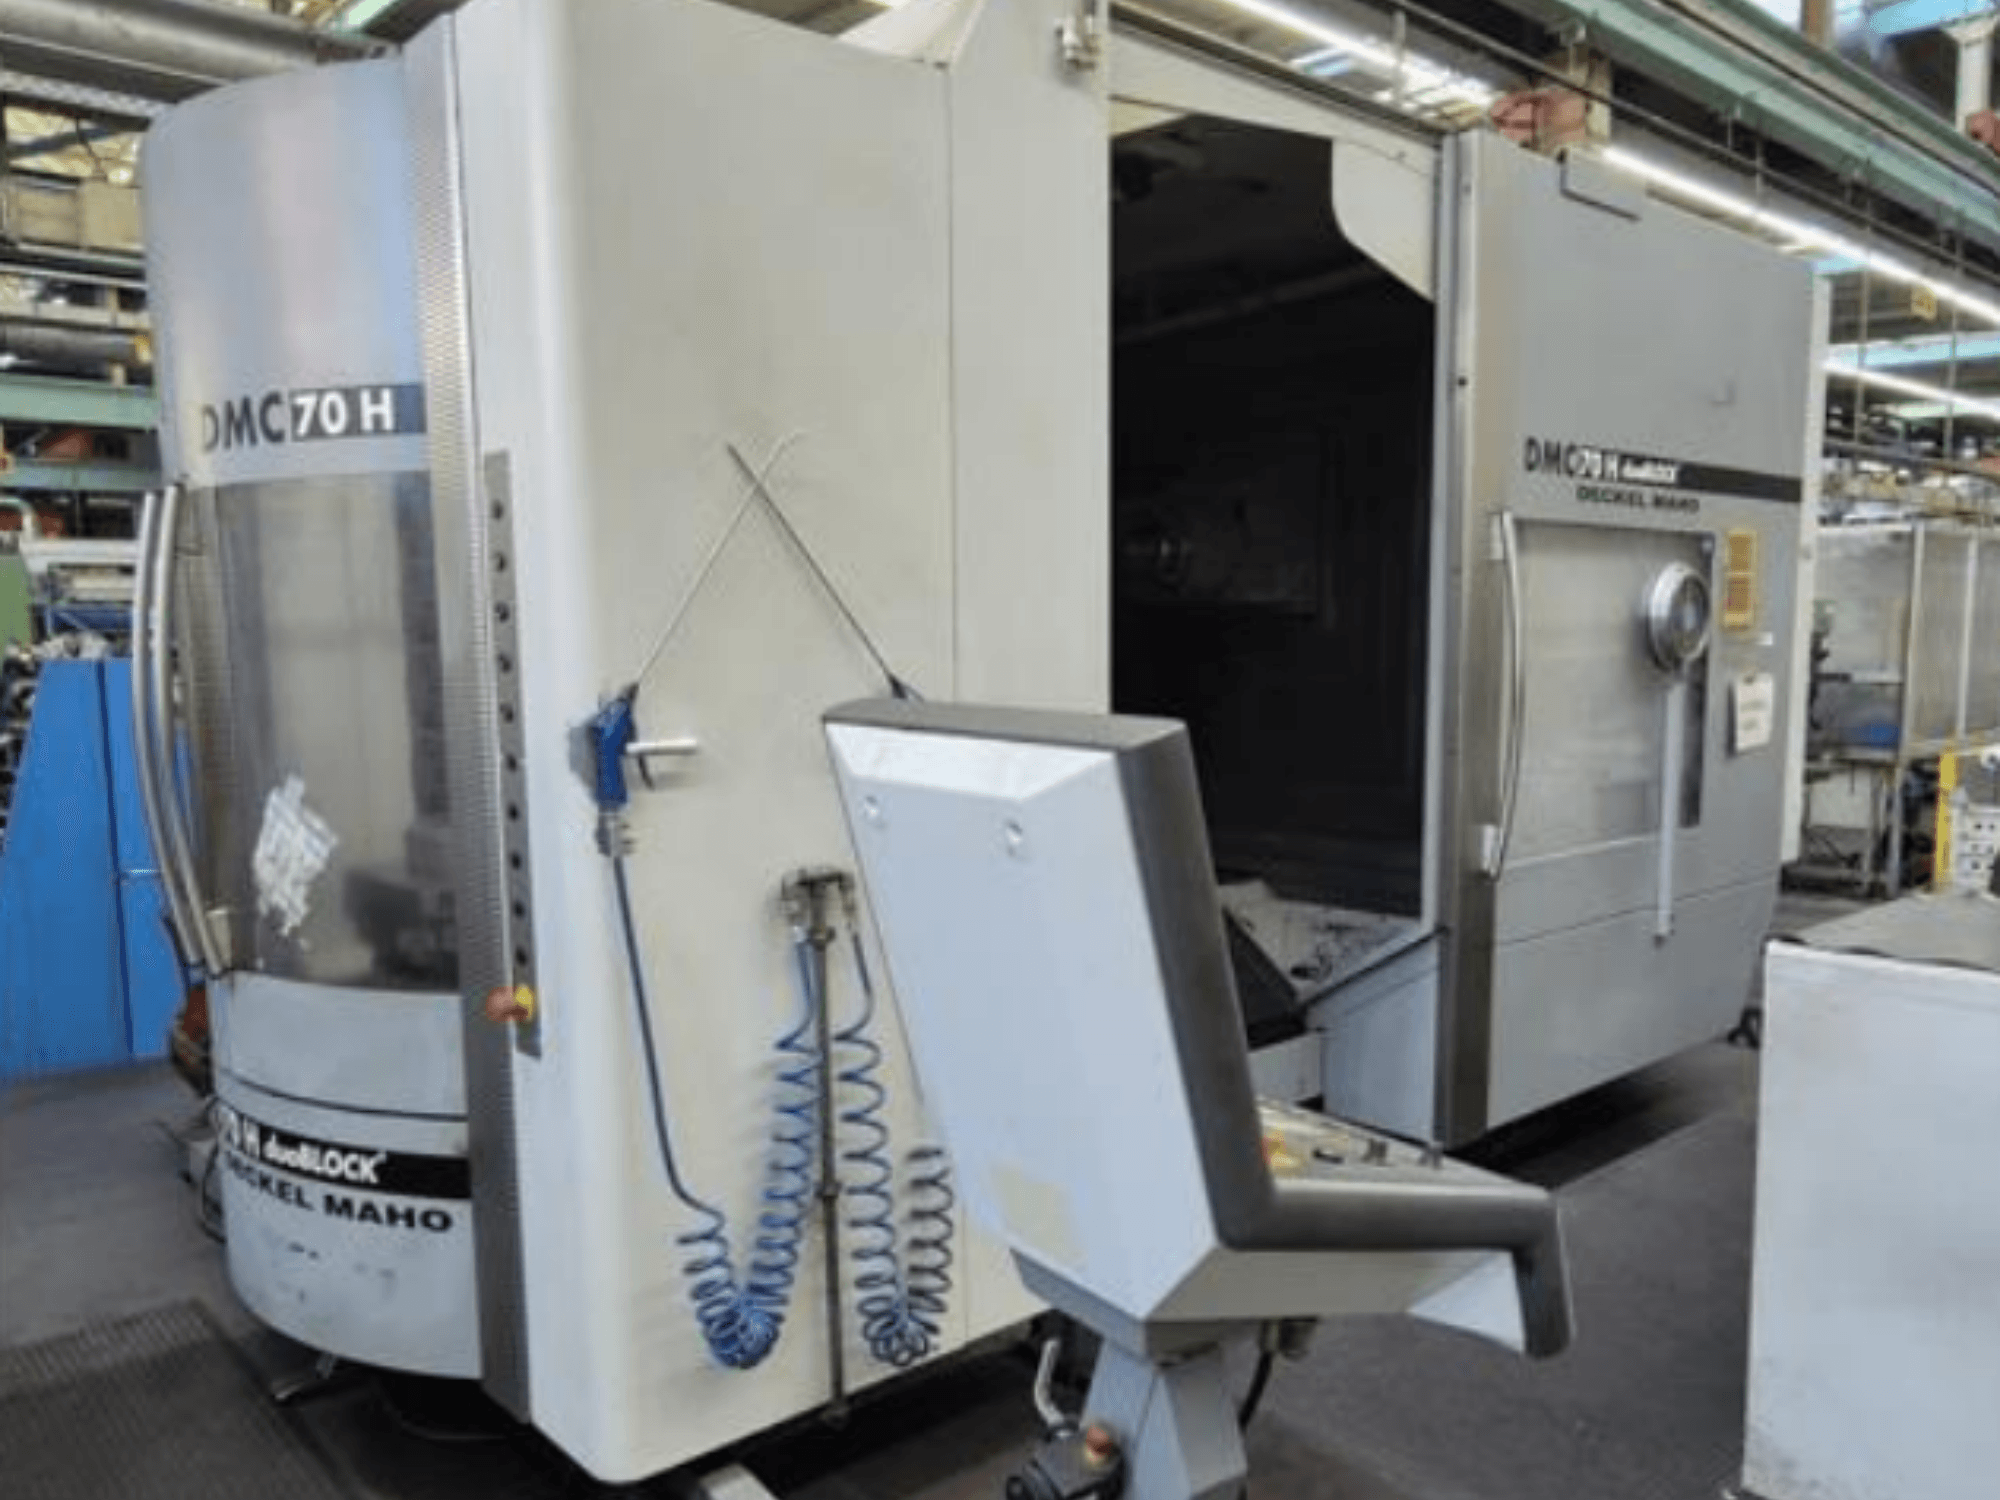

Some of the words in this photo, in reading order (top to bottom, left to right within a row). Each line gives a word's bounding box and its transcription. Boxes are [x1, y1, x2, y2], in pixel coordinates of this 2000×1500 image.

[201, 391, 285, 453] DMC
[292, 390, 347, 437] 70
[359, 387, 395, 432] H
[323, 1193, 453, 1233] MAHO
